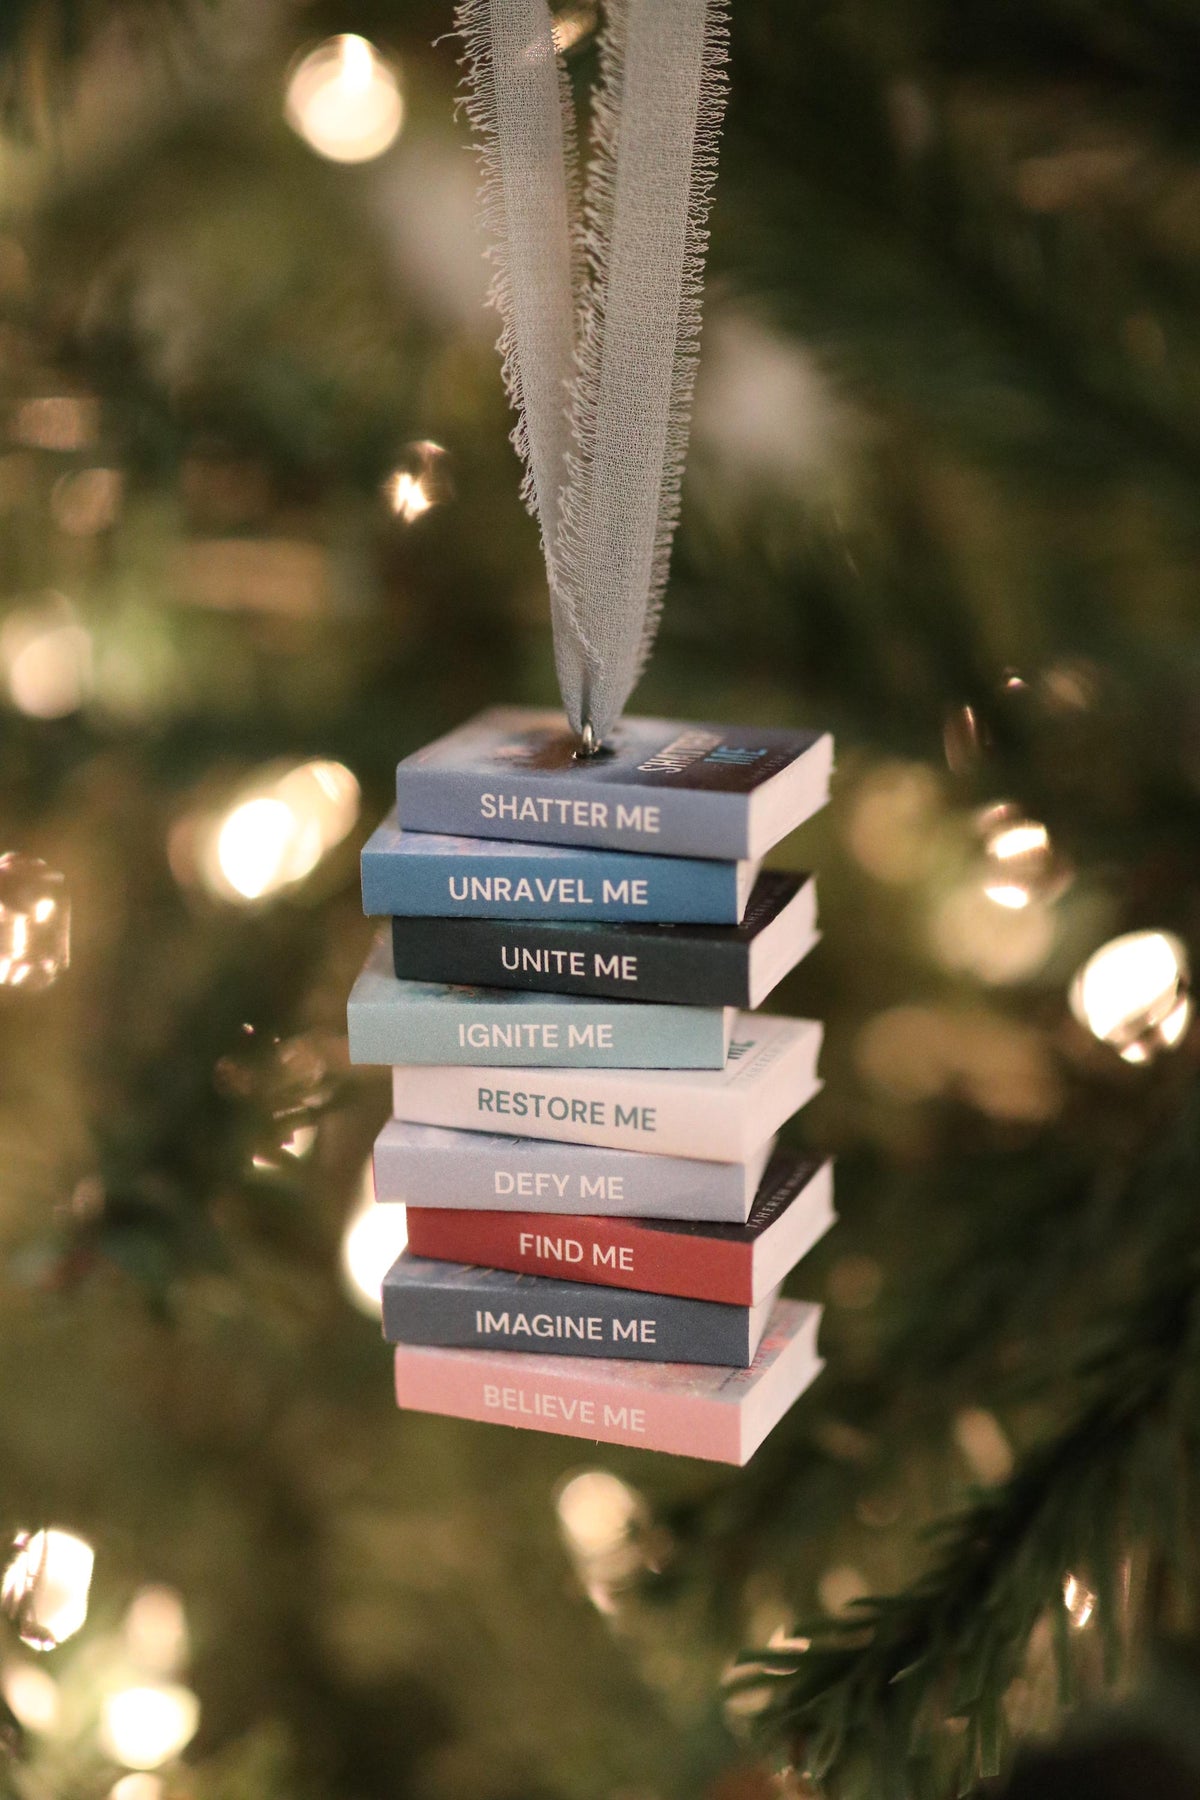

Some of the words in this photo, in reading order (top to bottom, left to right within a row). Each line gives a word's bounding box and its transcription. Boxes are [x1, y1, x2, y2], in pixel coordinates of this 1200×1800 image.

[480, 793, 608, 828] SHATTER
[616, 803, 661, 833] ME
[448, 876, 593, 905] UNRAVEL
[603, 879, 649, 905] ME
[500, 946, 586, 977] UNITE
[594, 954, 639, 981] ME
[458, 1023, 559, 1048] IGNITE
[568, 1024, 614, 1048] ME
[477, 1088, 606, 1126] RESTORE
[614, 1105, 657, 1132] ME
[493, 1171, 571, 1198] DEFY
[579, 1175, 624, 1201] ME
[518, 1232, 584, 1264] FIND
[592, 1244, 635, 1271] ME
[475, 1310, 604, 1341] IMAGINE
[612, 1316, 657, 1343] ME
[482, 1384, 595, 1426] BELIEVE
[603, 1404, 646, 1433] ME
